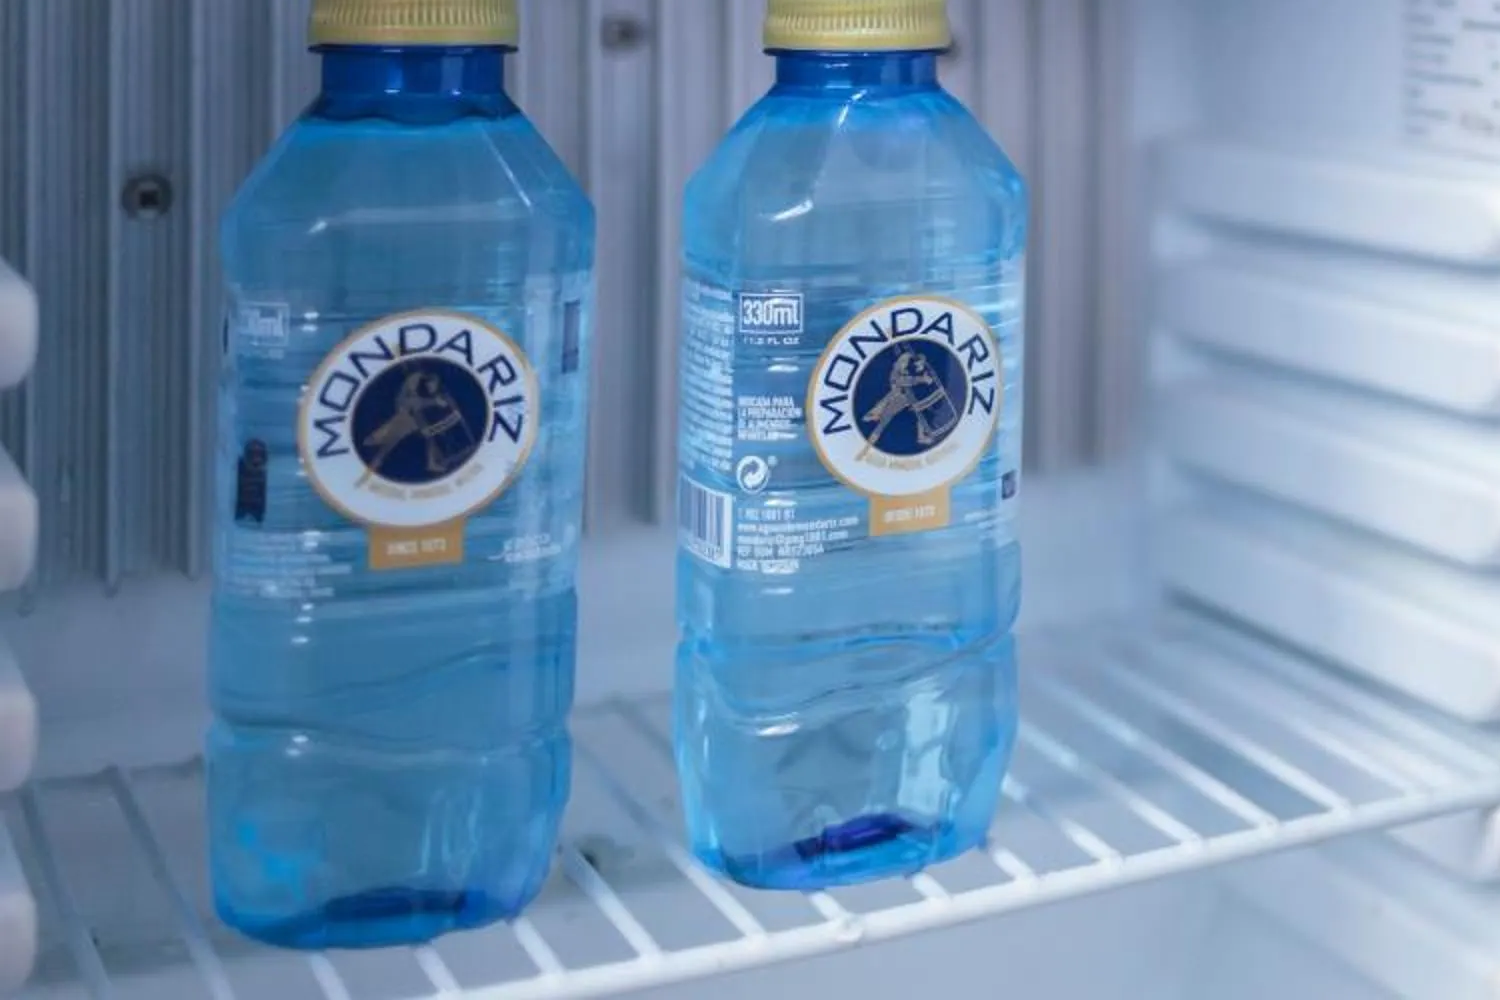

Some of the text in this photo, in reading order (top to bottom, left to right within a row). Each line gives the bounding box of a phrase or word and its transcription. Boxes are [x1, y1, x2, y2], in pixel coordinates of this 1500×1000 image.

[743, 299, 800, 326] 330ml
[820, 306, 996, 435] MONDARIZ
[312, 322, 525, 460] MONDARIZ
